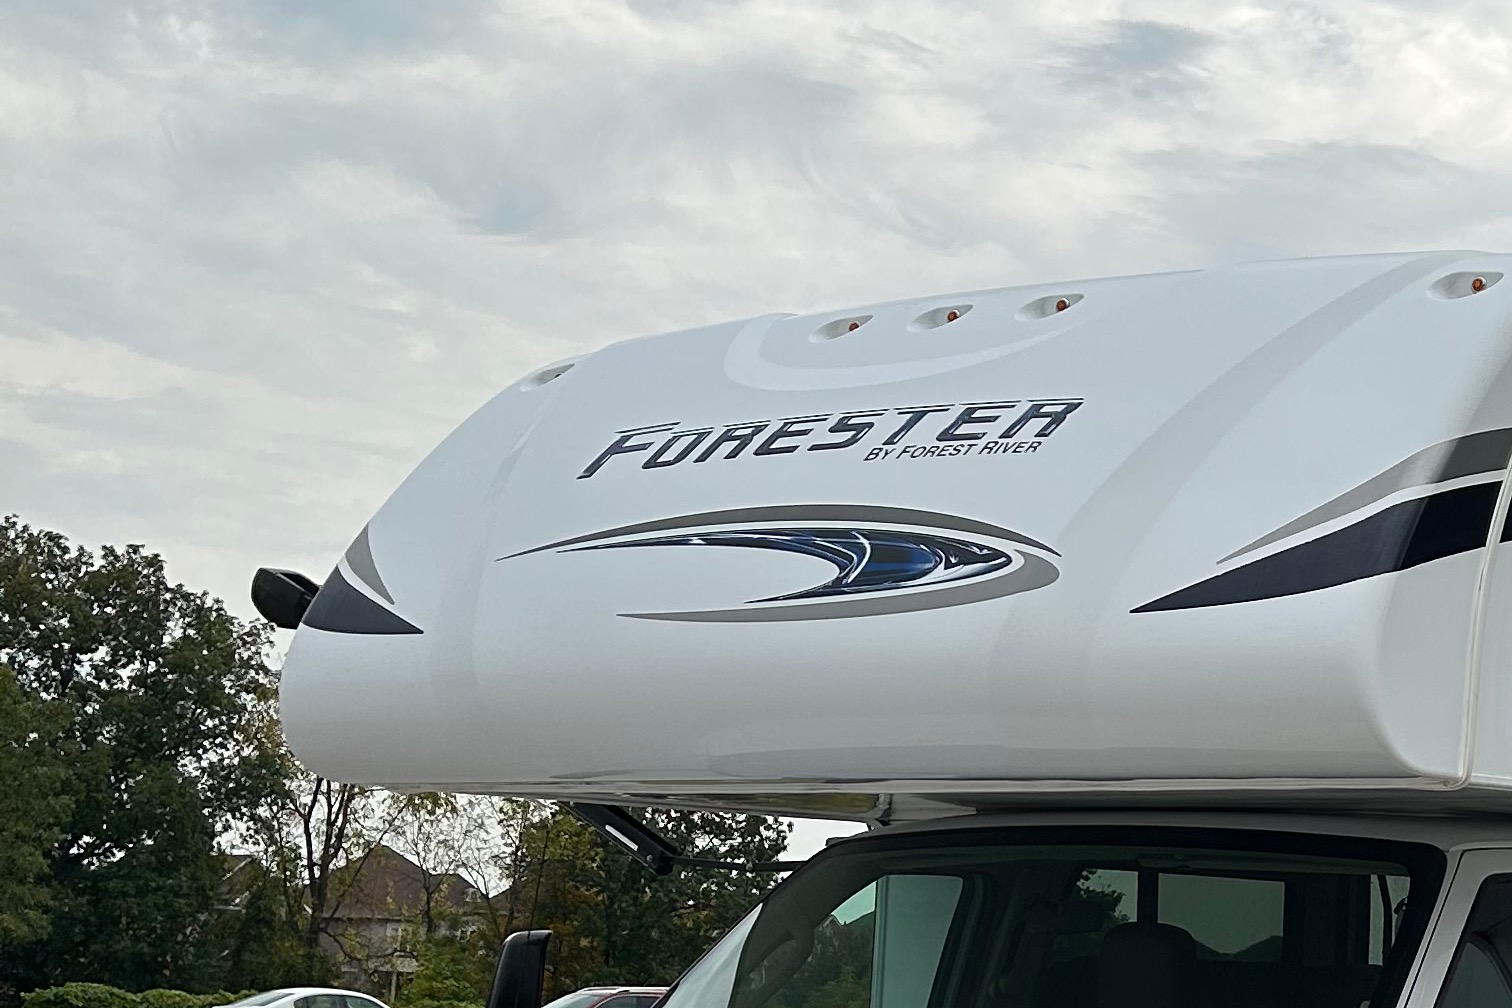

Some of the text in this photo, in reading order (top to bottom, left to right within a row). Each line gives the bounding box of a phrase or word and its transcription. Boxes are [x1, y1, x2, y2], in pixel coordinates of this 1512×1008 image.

[576, 398, 1084, 480] FORESTER
[863, 440, 1042, 461] BY FOREST RIVER
